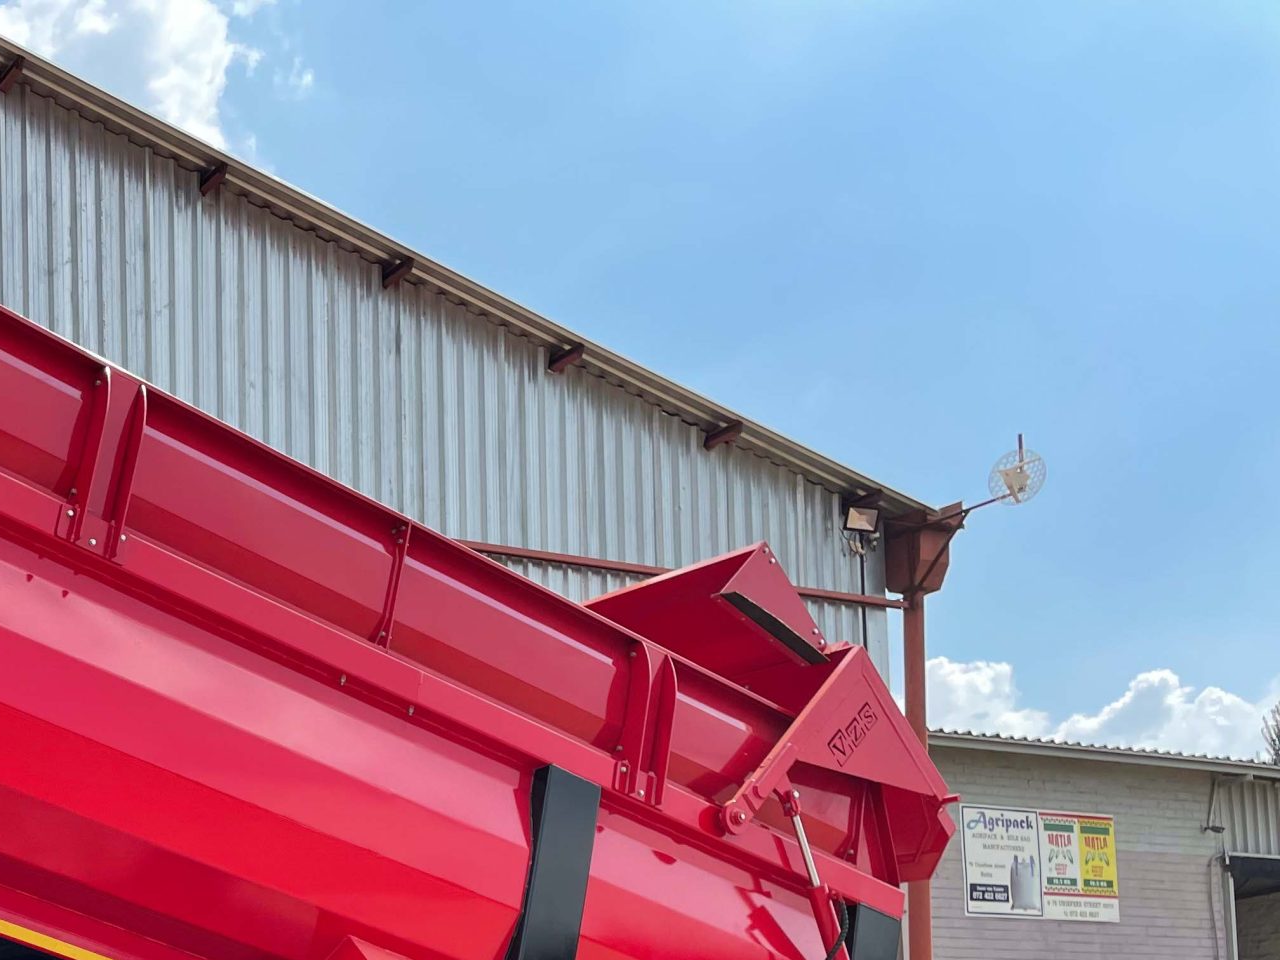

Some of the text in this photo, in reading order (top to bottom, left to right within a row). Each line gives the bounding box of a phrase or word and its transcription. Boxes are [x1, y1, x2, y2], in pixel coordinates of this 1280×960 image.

[966, 811, 1034, 834] Agripack
[1047, 833, 1072, 849] MATLA
[1084, 836, 1108, 851] MATLA
